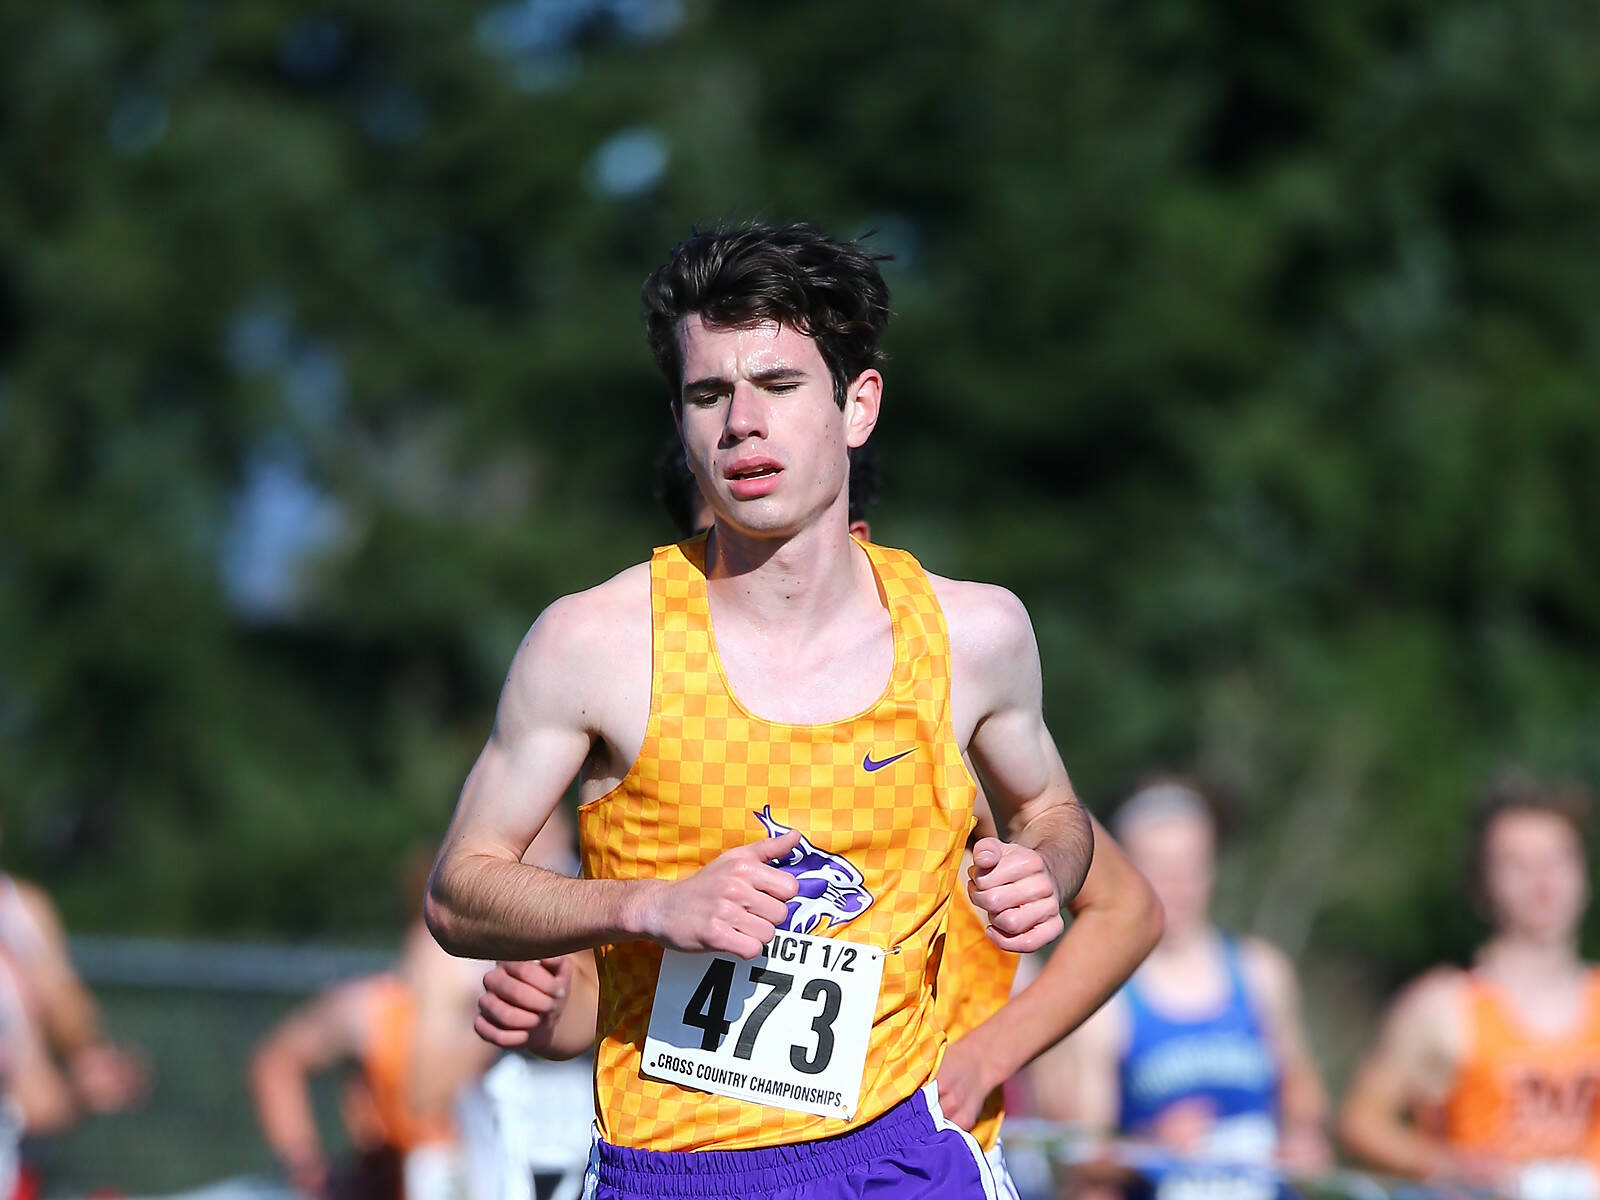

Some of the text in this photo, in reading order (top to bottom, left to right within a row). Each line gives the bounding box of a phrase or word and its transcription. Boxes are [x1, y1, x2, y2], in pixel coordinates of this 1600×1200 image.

[822, 944, 857, 973] 1/2
[682, 958, 842, 1074] 473
[657, 1053, 694, 1075] CROSS
[697, 1064, 748, 1089] COUNTRY
[749, 1076, 842, 1107] CHAMPIONSHIPS
